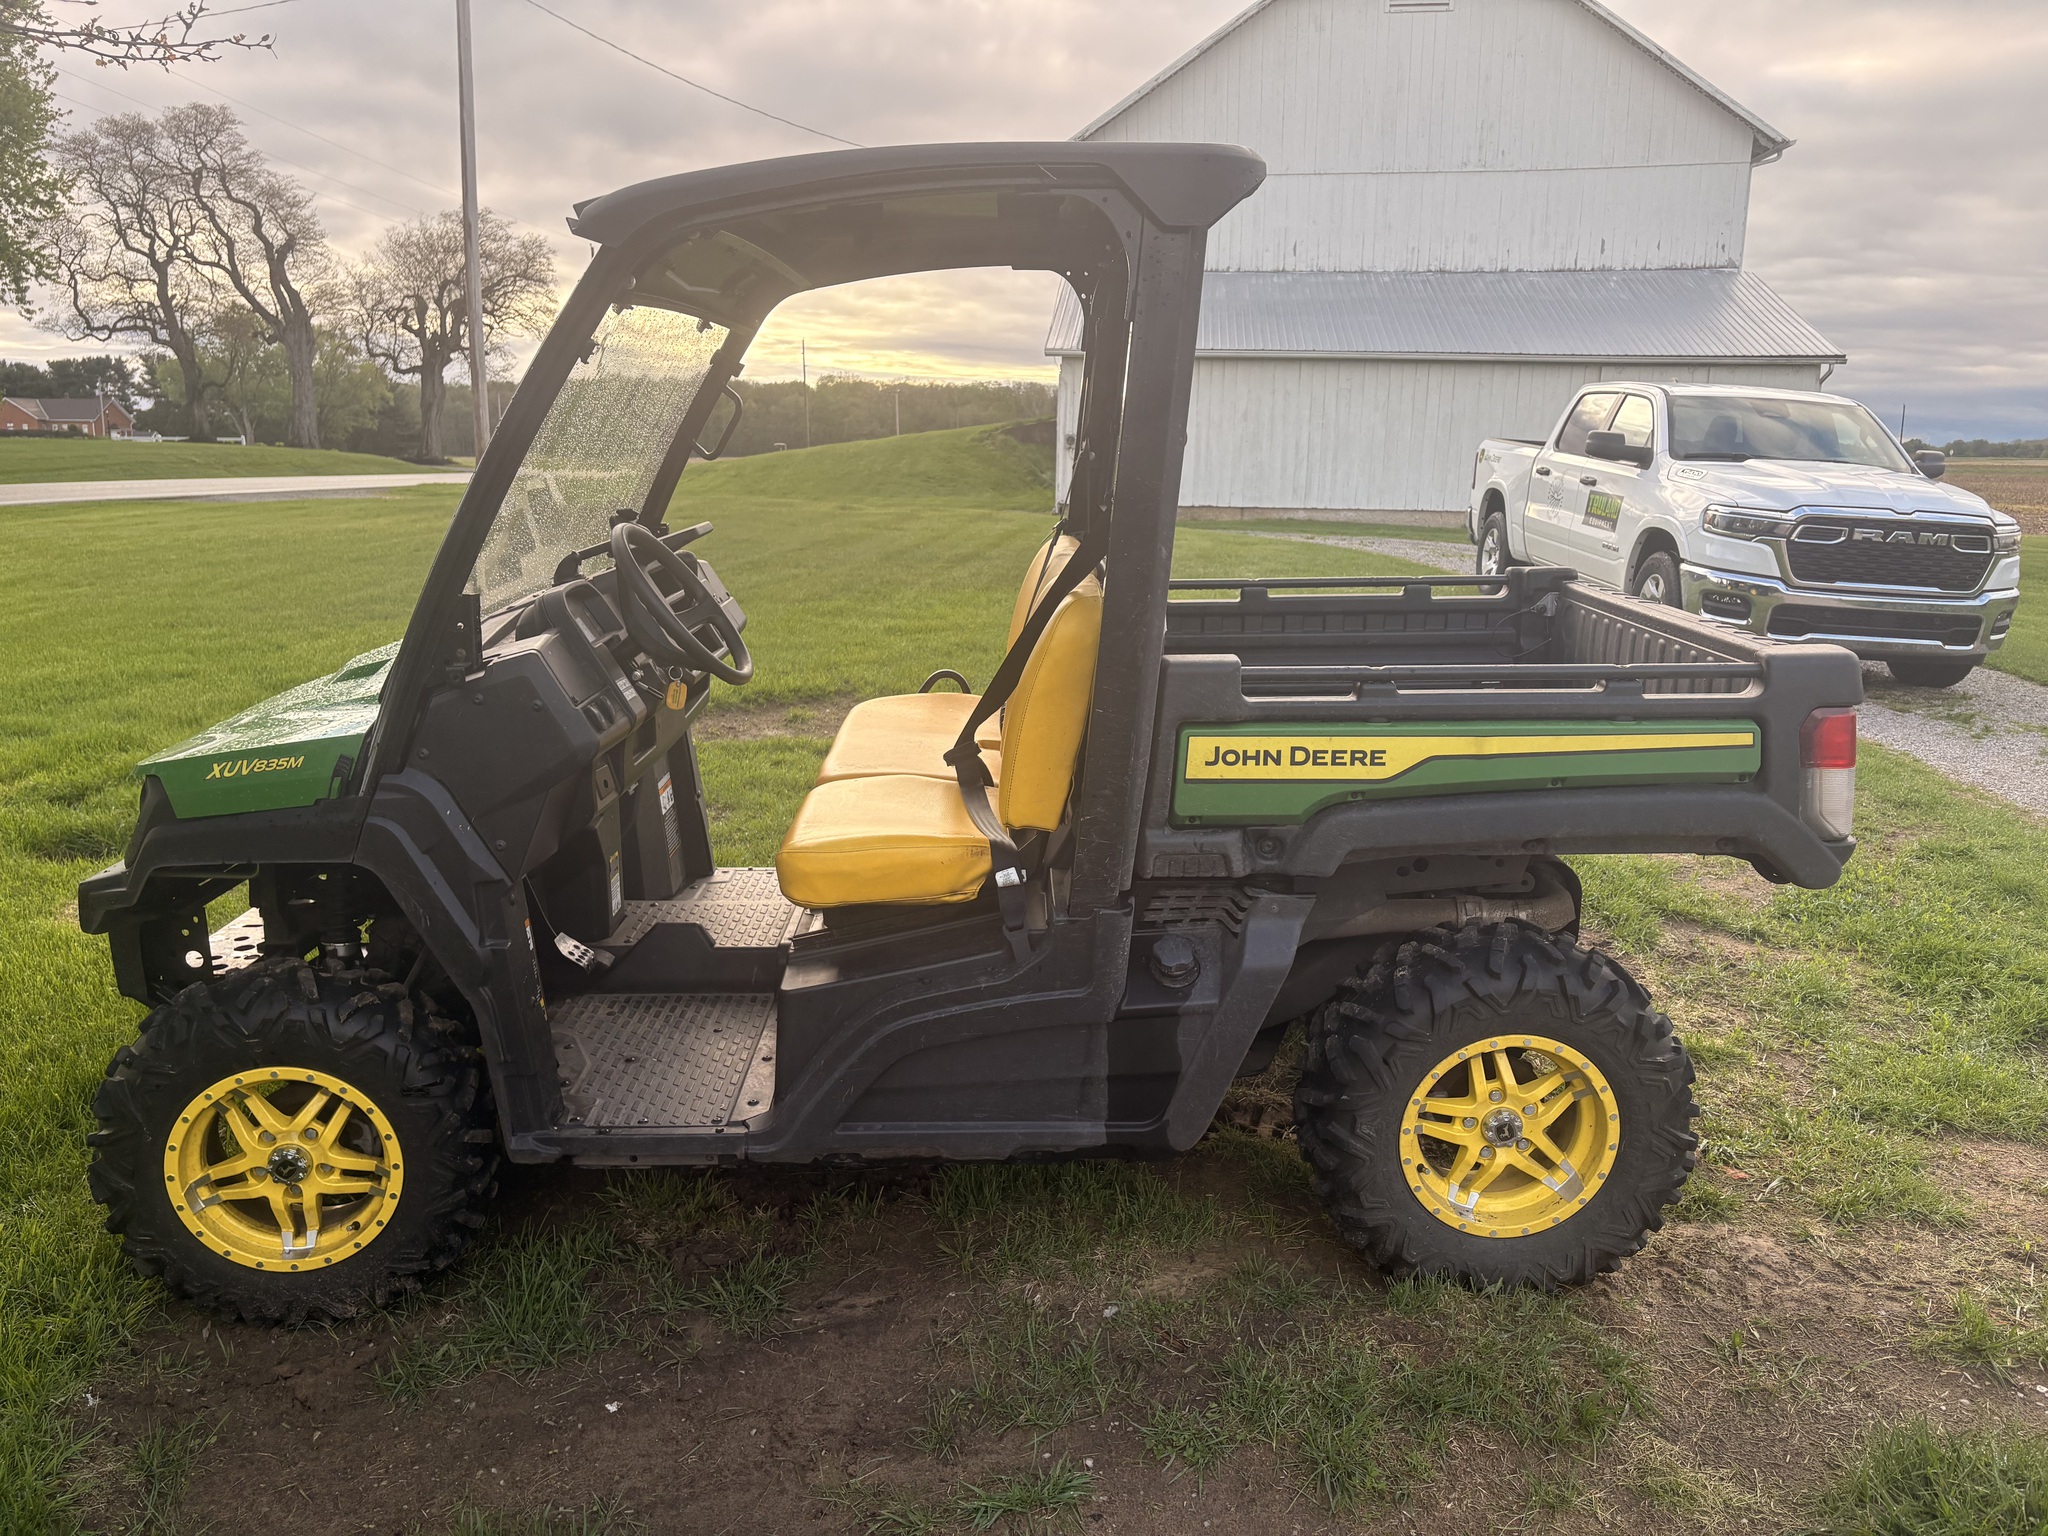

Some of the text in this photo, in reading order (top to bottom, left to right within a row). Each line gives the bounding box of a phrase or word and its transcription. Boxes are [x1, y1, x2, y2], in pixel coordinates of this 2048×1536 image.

[1588, 494, 1621, 519] TRULAND
[1852, 527, 1950, 546] RAM
[204, 755, 306, 780] XUV835M
[1204, 745, 1388, 767] JOHN DEERE
